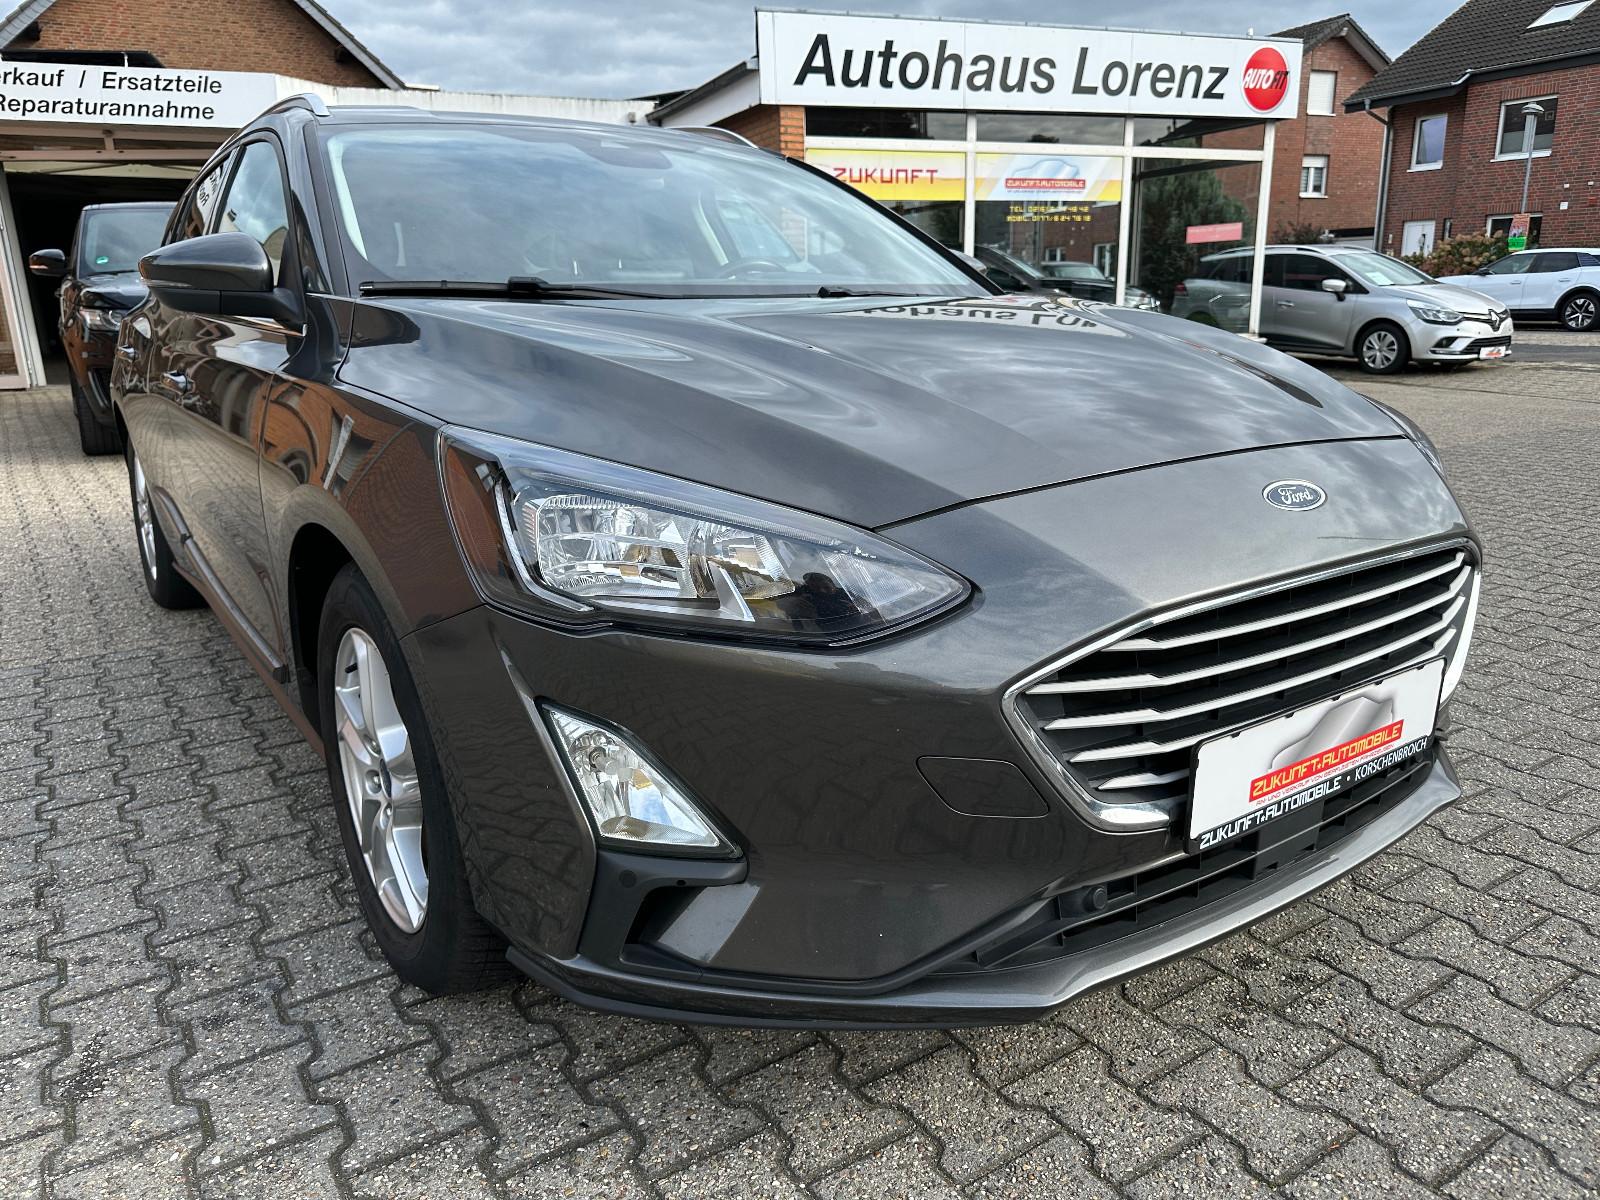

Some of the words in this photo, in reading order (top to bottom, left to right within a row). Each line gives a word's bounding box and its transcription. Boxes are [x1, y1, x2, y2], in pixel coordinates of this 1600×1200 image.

[793, 33, 1057, 94] Autohaus
[1072, 46, 1230, 100] Lorenz
[0, 67, 65, 87] rkauf
[102, 71, 223, 94] Ersatzteile
[0, 93, 215, 119] Reparaturannahme
[833, 167, 938, 184] ZUKUNFT
[1277, 486, 1314, 504] Ford
[1355, 737, 1428, 781] KORSCHENBROICH
